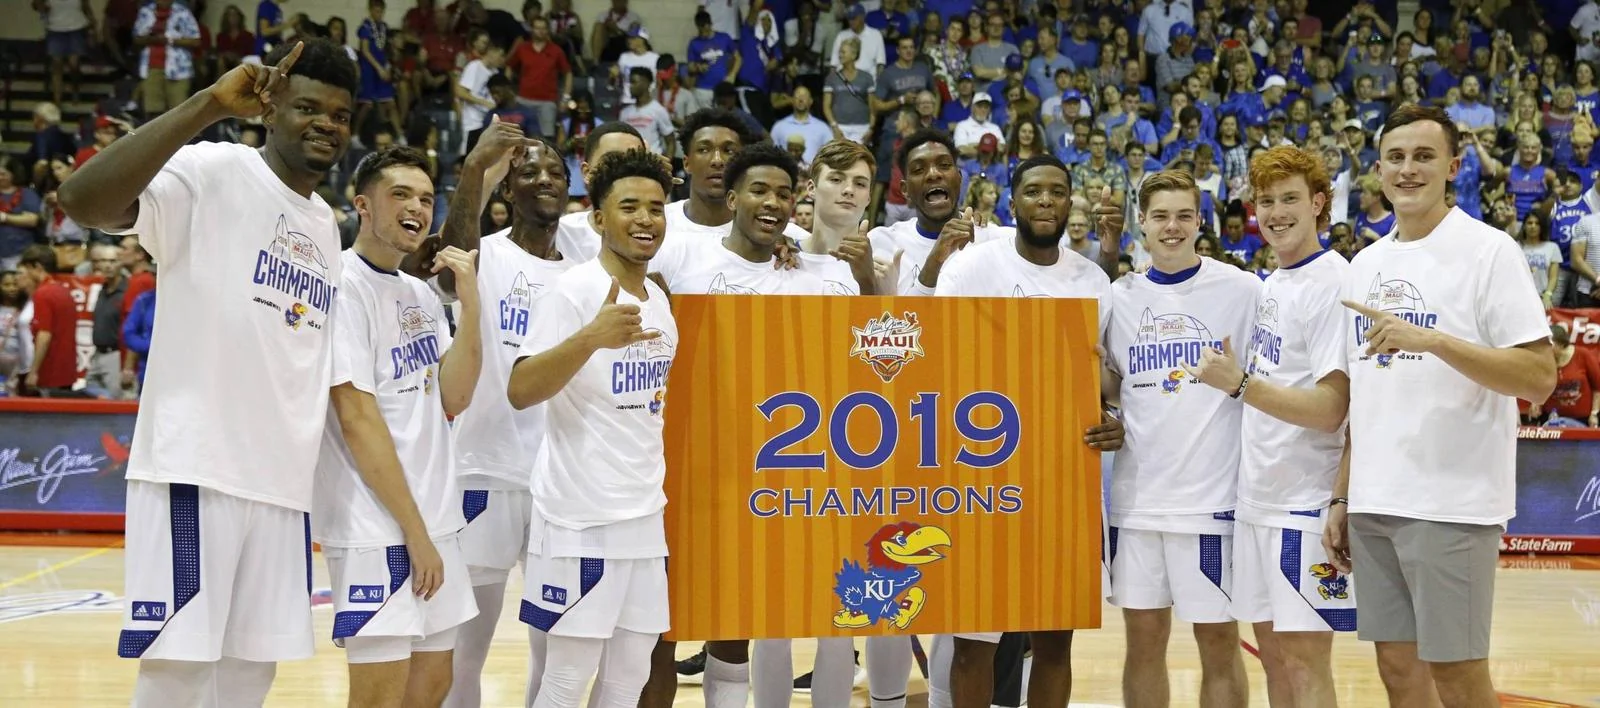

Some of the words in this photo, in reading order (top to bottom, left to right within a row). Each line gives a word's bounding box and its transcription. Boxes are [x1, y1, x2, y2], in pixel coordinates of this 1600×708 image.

[860, 335, 915, 349] MAUI
[755, 390, 1022, 472] 2019
[748, 485, 1024, 518] CHAMPIONS
[369, 589, 382, 599] KU
[863, 579, 896, 601] KU
[152, 606, 165, 617] KU
